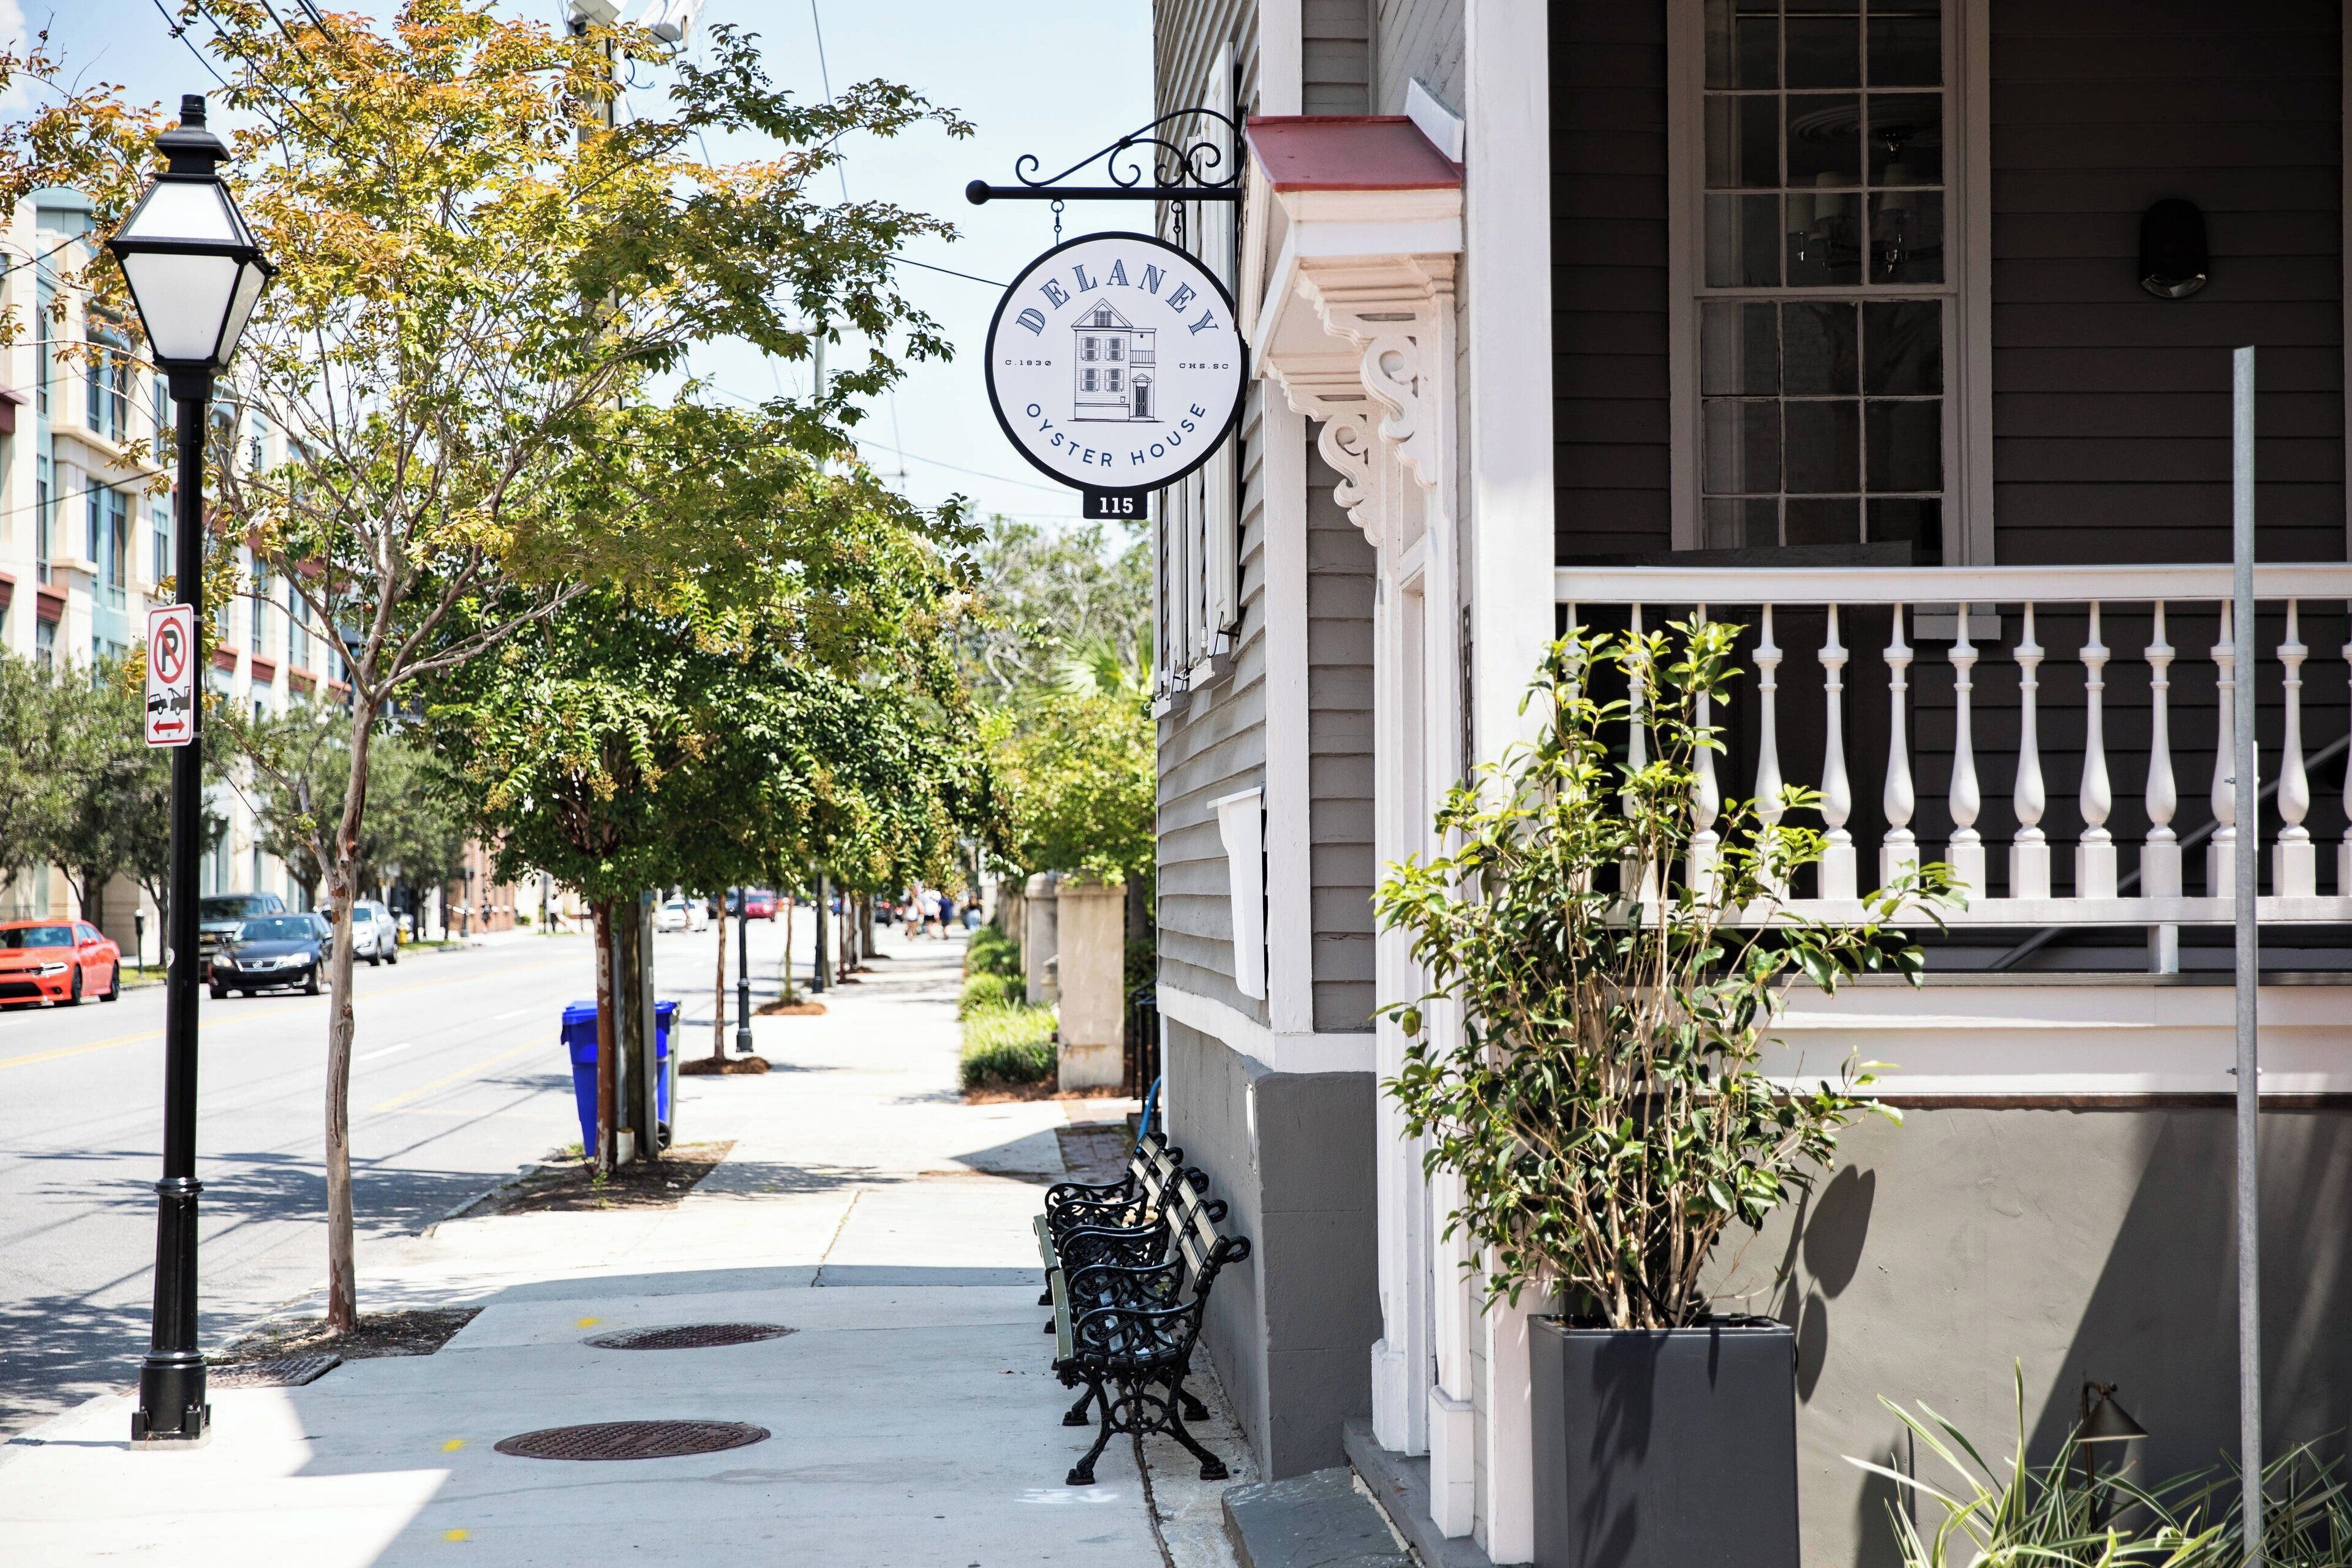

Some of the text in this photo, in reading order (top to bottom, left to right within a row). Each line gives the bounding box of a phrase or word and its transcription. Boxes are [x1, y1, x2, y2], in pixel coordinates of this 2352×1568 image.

[1016, 258, 1219, 336] DELANEY
[1027, 403, 1206, 467] OYSTER HOUSE
[1099, 497, 1134, 514] 115
